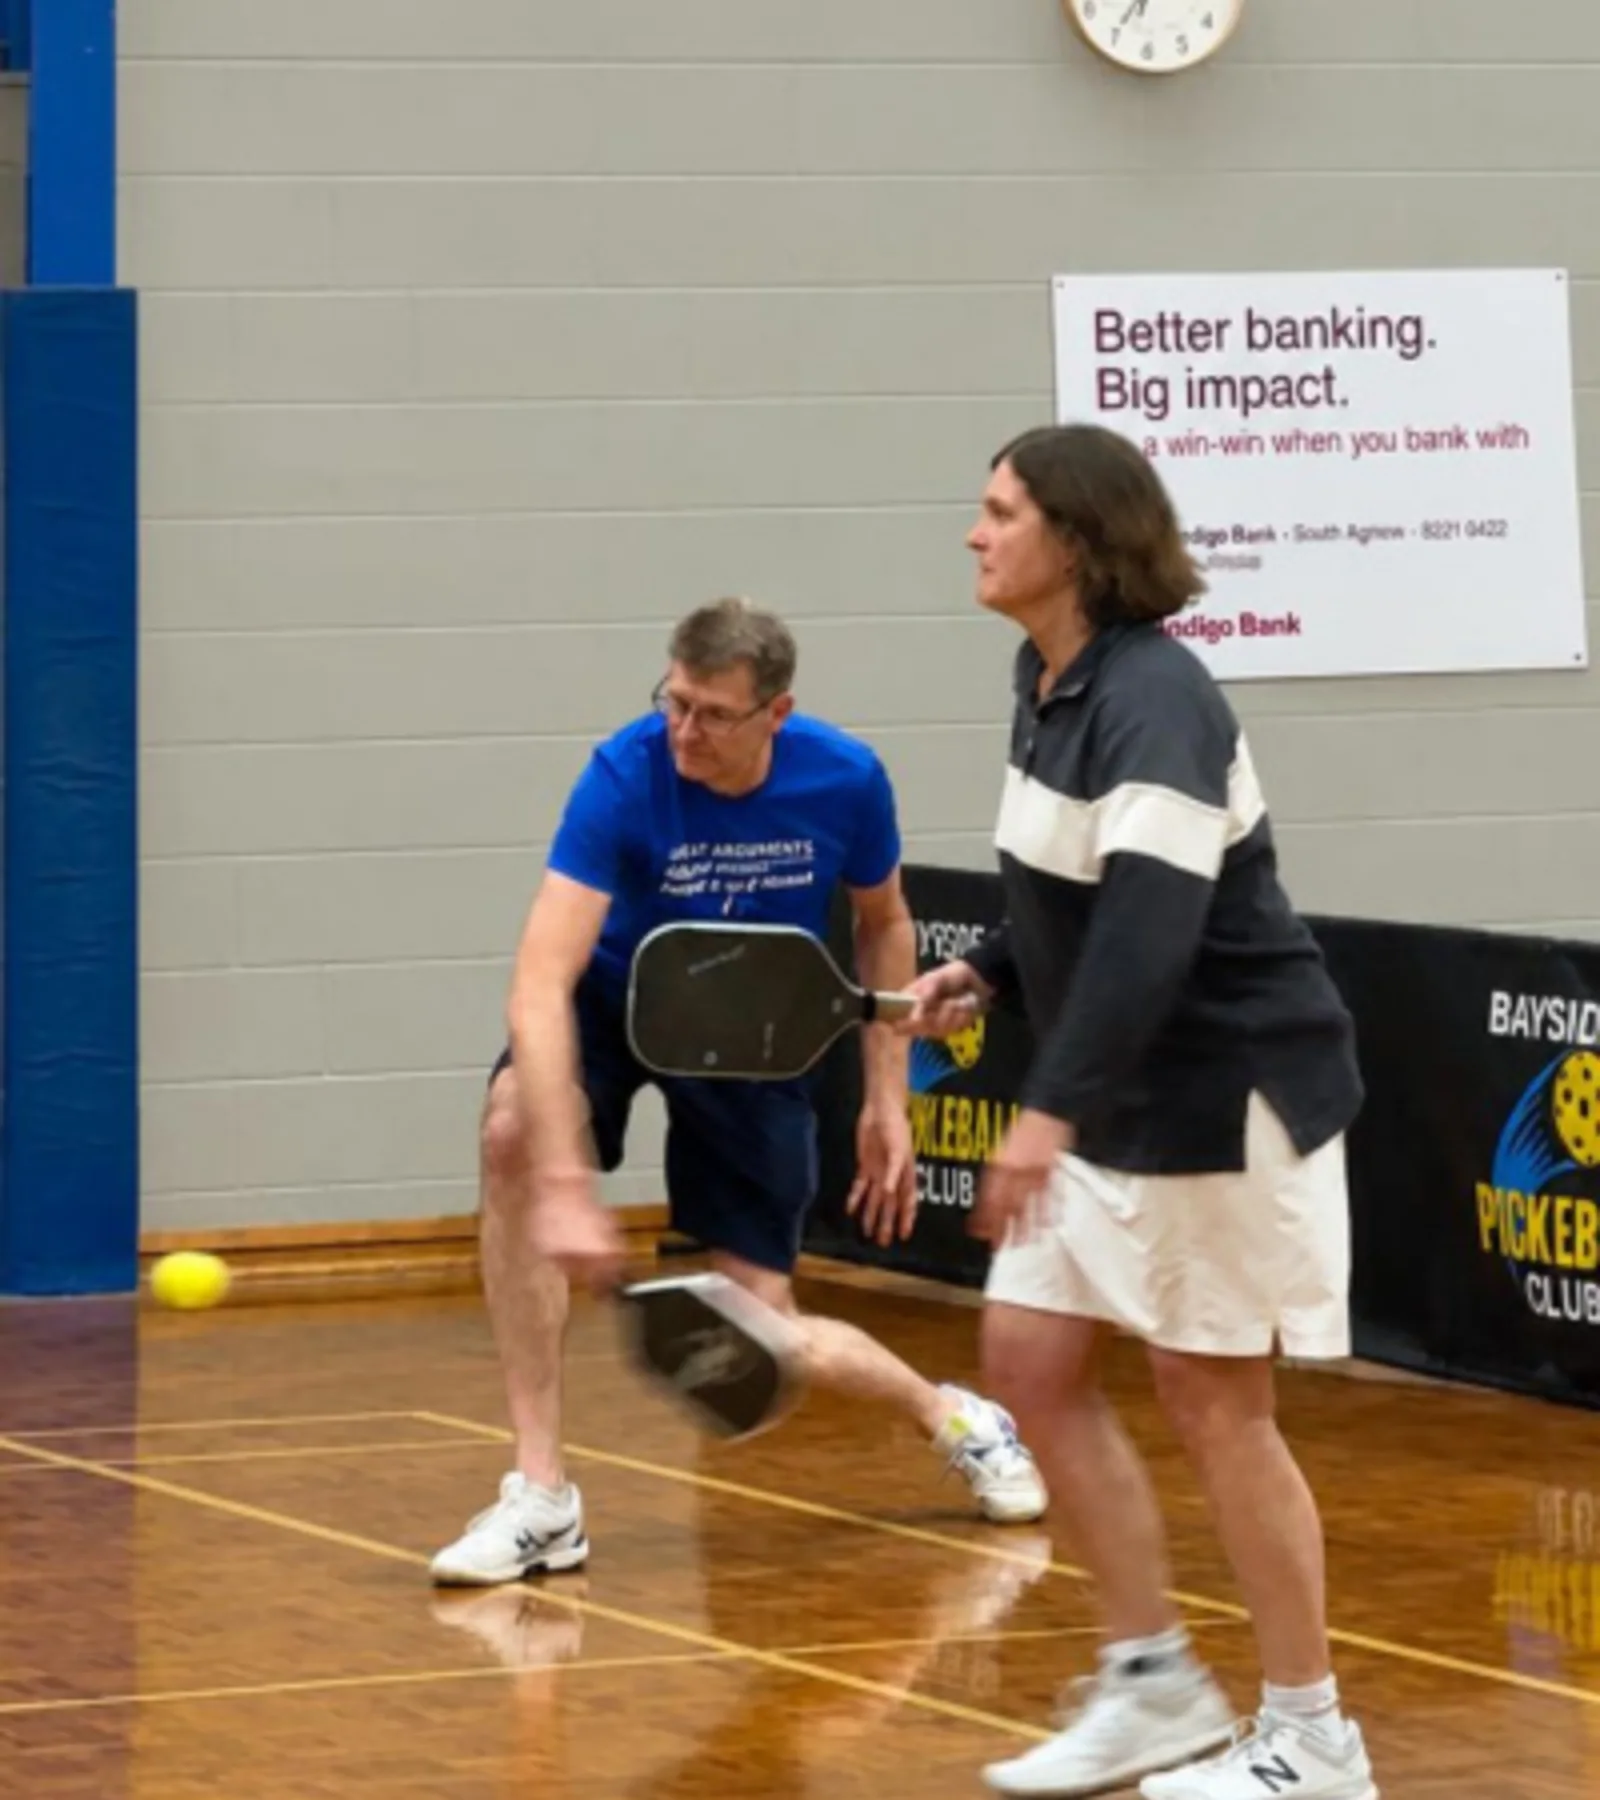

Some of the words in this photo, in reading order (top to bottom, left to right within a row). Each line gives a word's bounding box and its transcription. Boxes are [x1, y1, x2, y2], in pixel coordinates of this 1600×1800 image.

[1094, 308, 1232, 353] Better
[1246, 305, 1437, 361] banking.
[1097, 367, 1170, 421] Big
[1185, 364, 1349, 418] impact.
[1143, 436, 1158, 457] a
[1166, 428, 1264, 457] win-win
[1272, 427, 1342, 454] when
[1350, 430, 1397, 460] you
[1405, 424, 1469, 452] bank
[1476, 422, 1530, 449] with
[1231, 523, 1276, 545] Bank
[1162, 613, 1234, 645] ndigo
[1239, 610, 1301, 636] Bank
[1488, 990, 1600, 1045] BAYSID
[1475, 1183, 1600, 1270] PICKEB
[1525, 1271, 1600, 1325] CLUB
